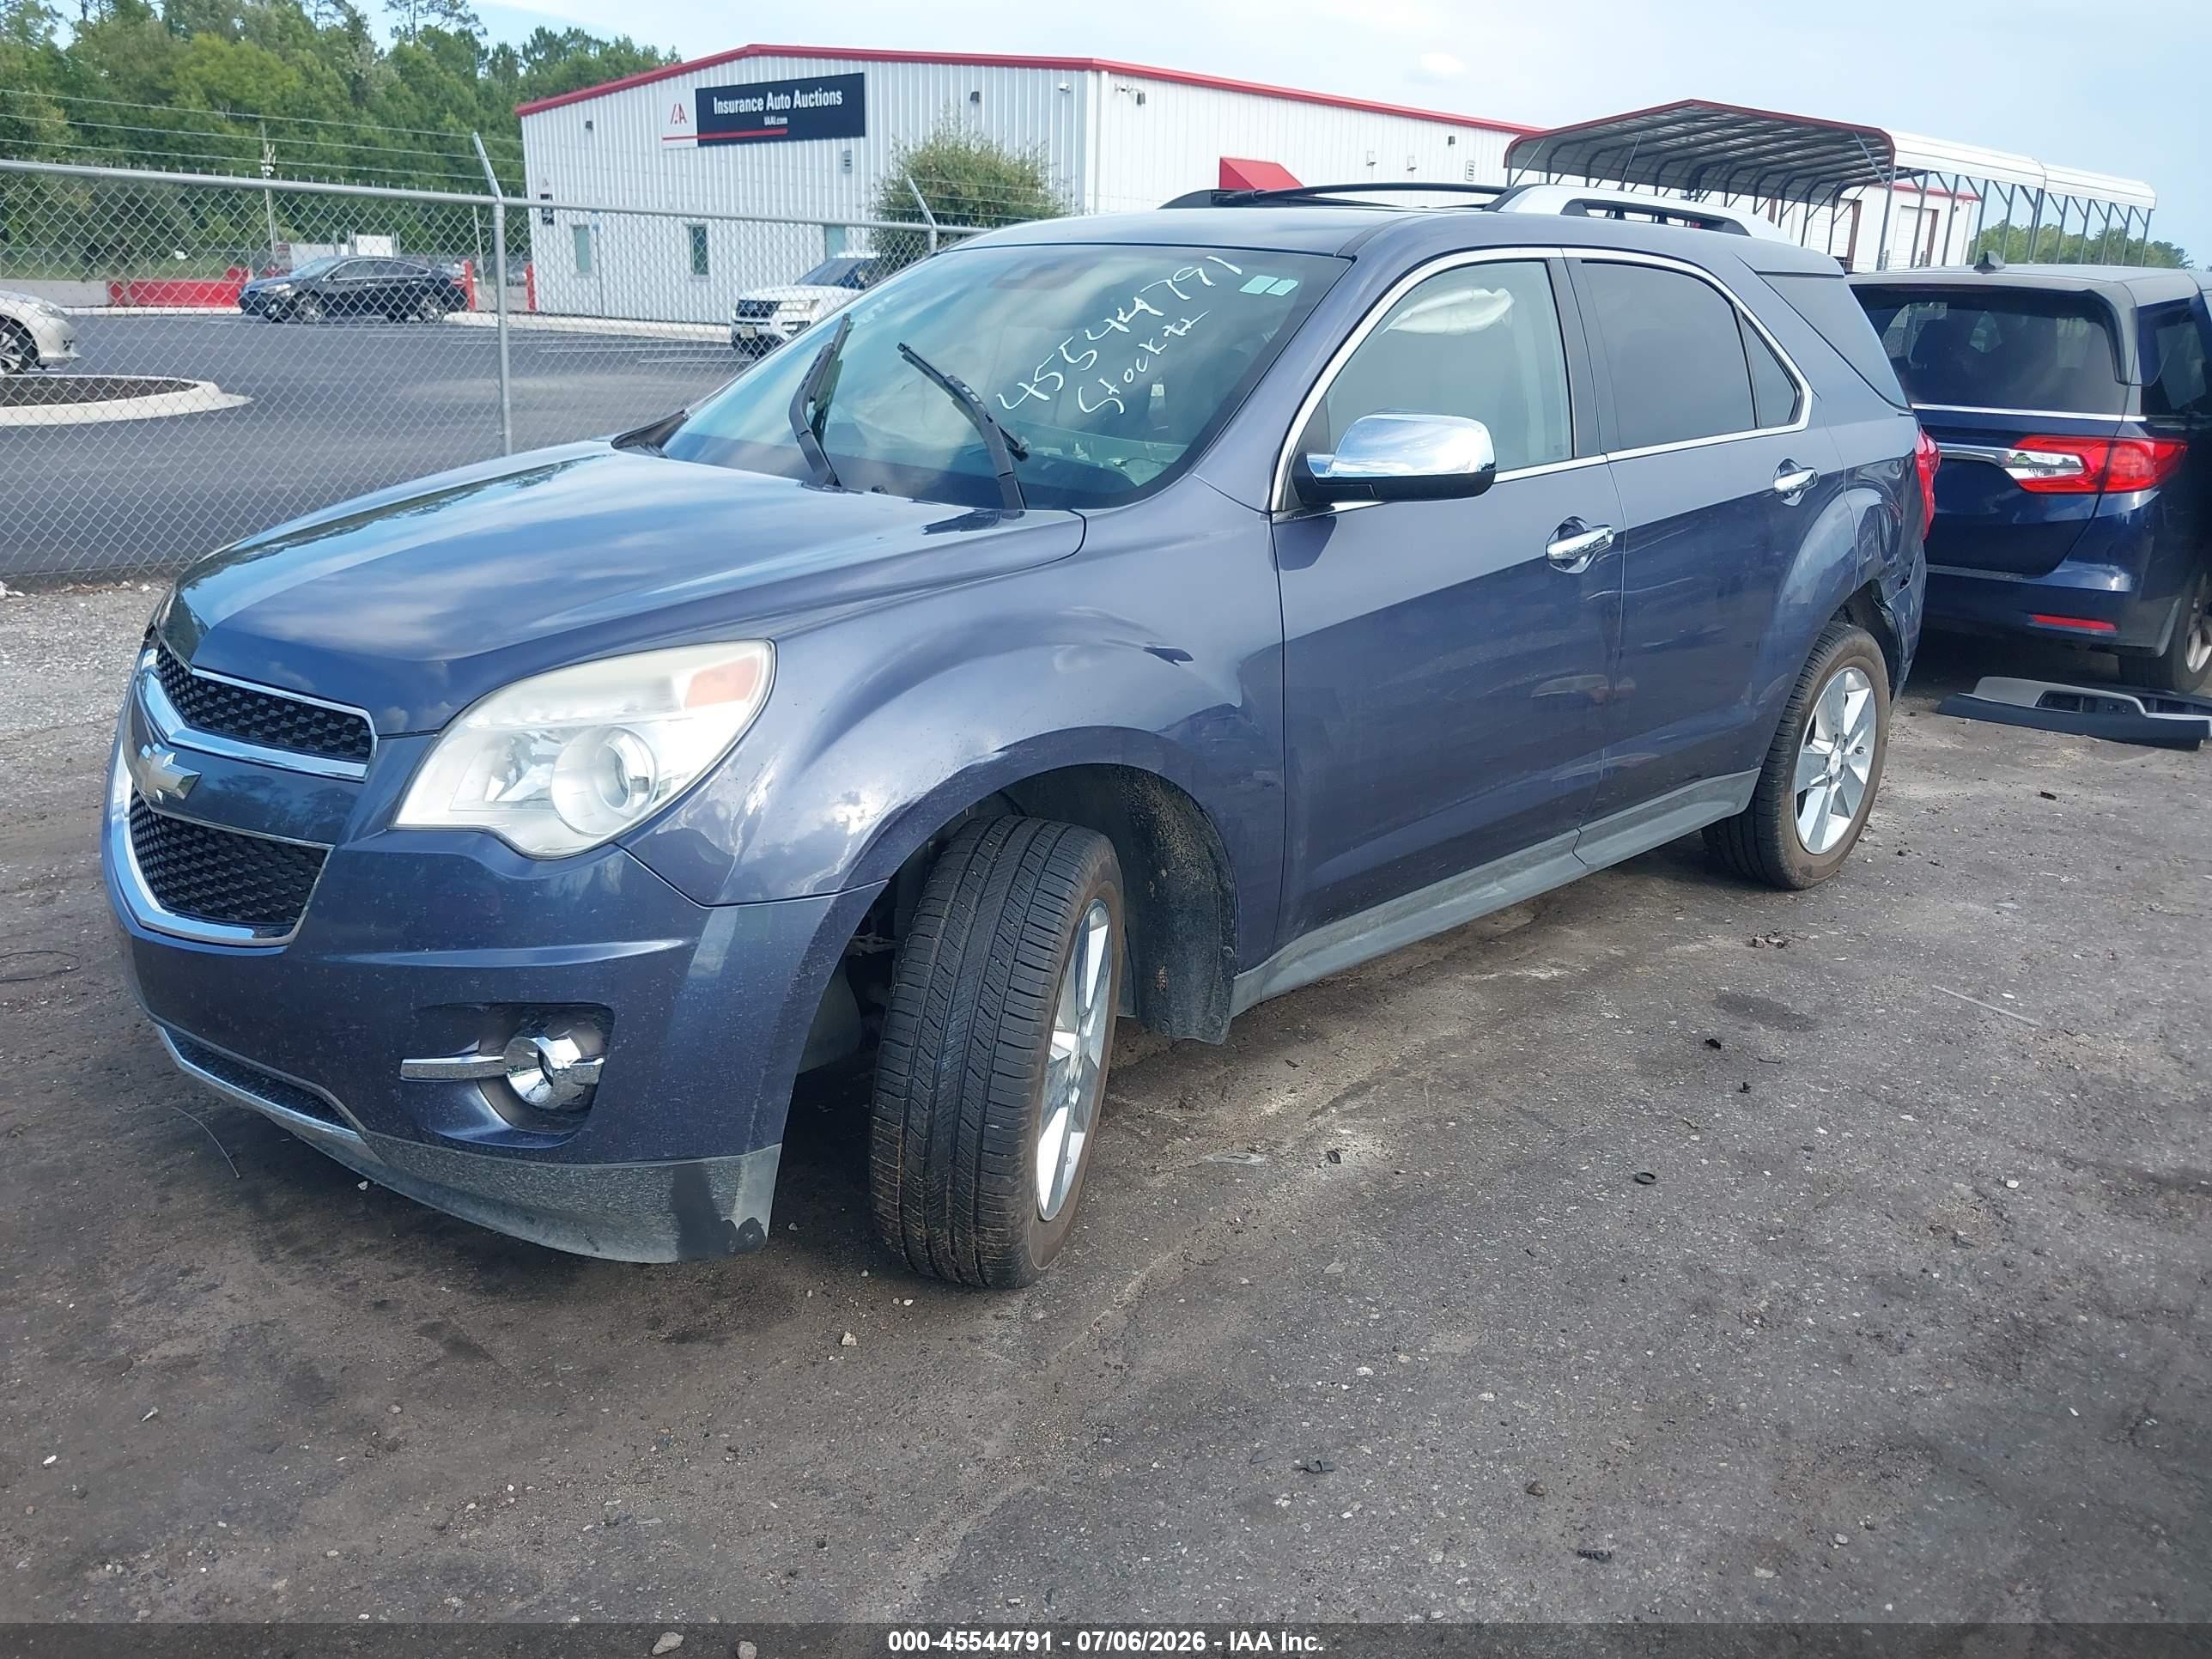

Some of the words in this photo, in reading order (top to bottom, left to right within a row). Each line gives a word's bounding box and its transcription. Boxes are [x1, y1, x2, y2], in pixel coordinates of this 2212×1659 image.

[714, 96, 764, 115] Insurance
[766, 91, 791, 111] Auto
[793, 87, 843, 109] Auctions
